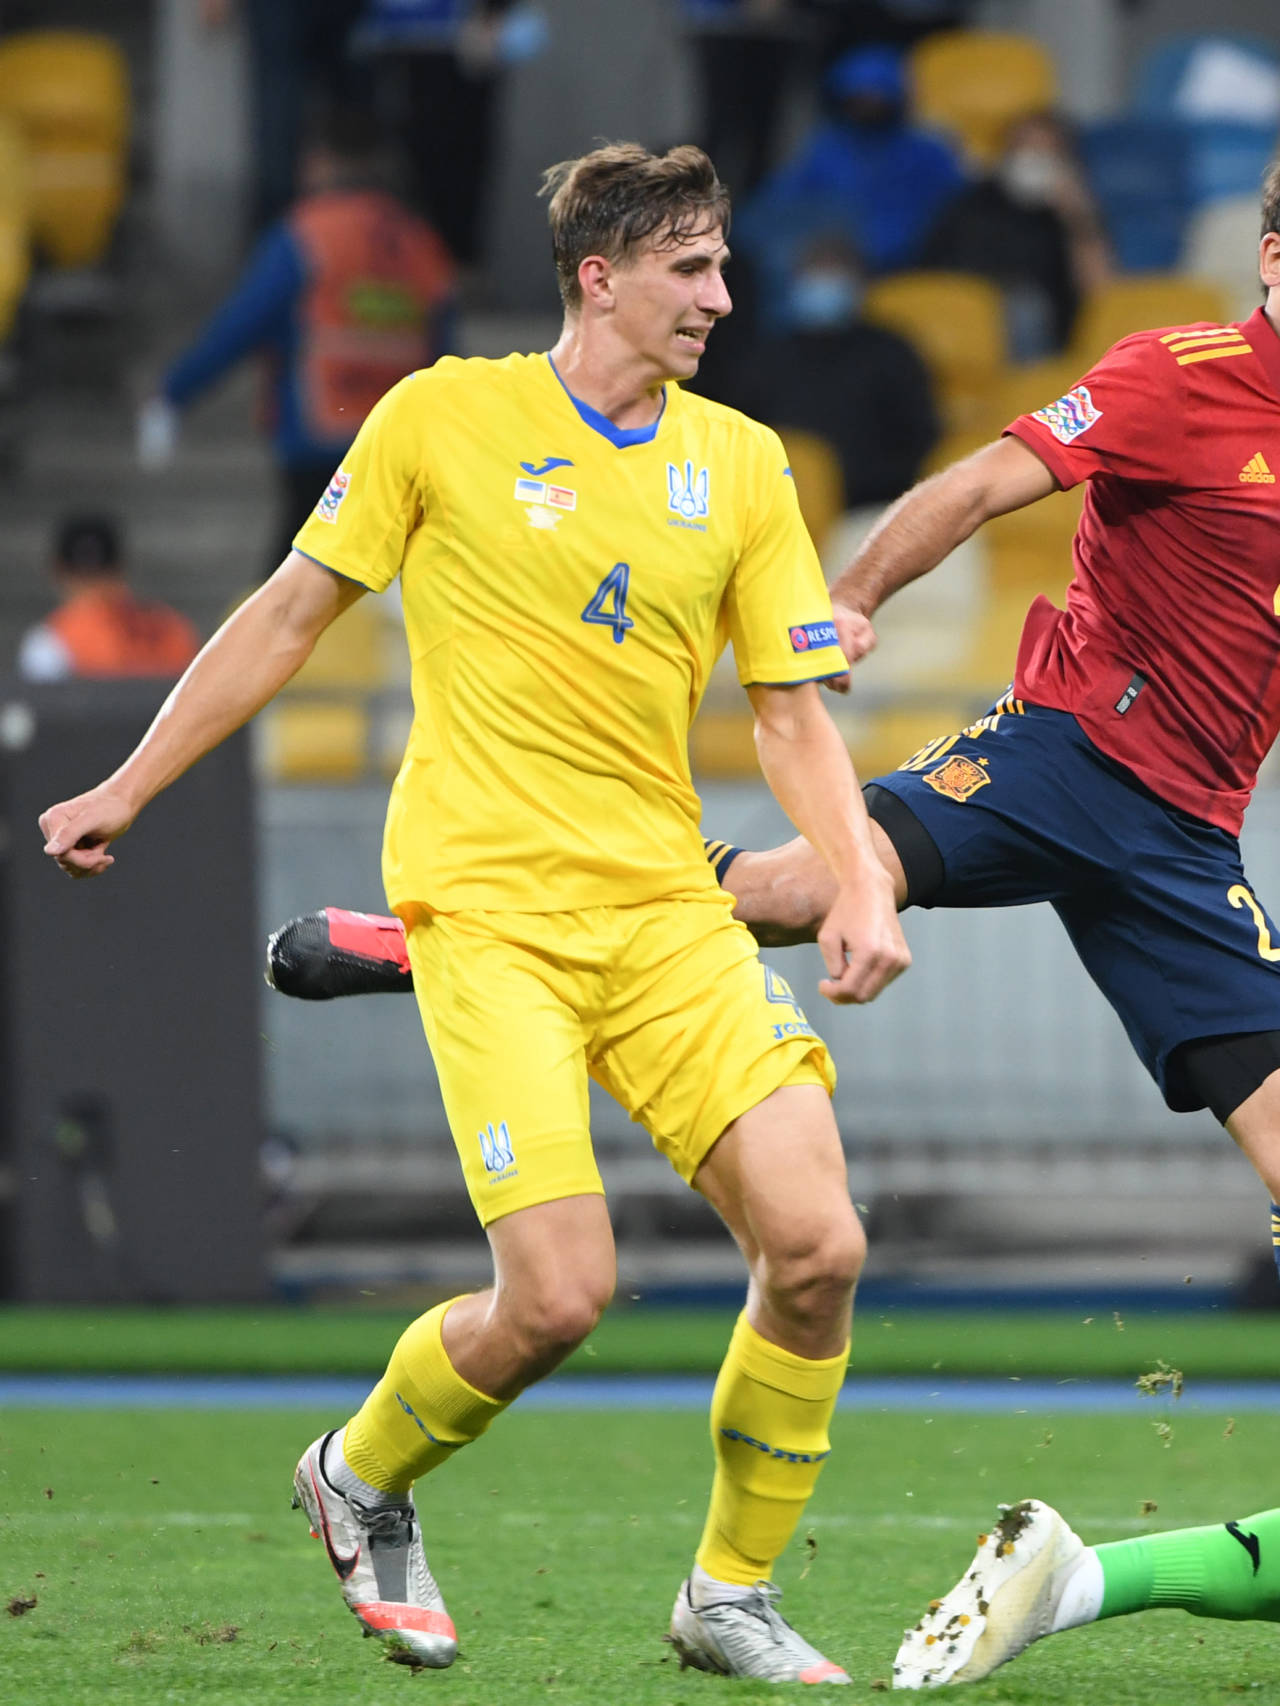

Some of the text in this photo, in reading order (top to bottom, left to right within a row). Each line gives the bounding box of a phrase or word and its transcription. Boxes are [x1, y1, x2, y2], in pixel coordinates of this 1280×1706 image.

[1239, 473, 1275, 483] adidas
[667, 518, 707, 532] UKRAINE
[581, 562, 634, 644] 4
